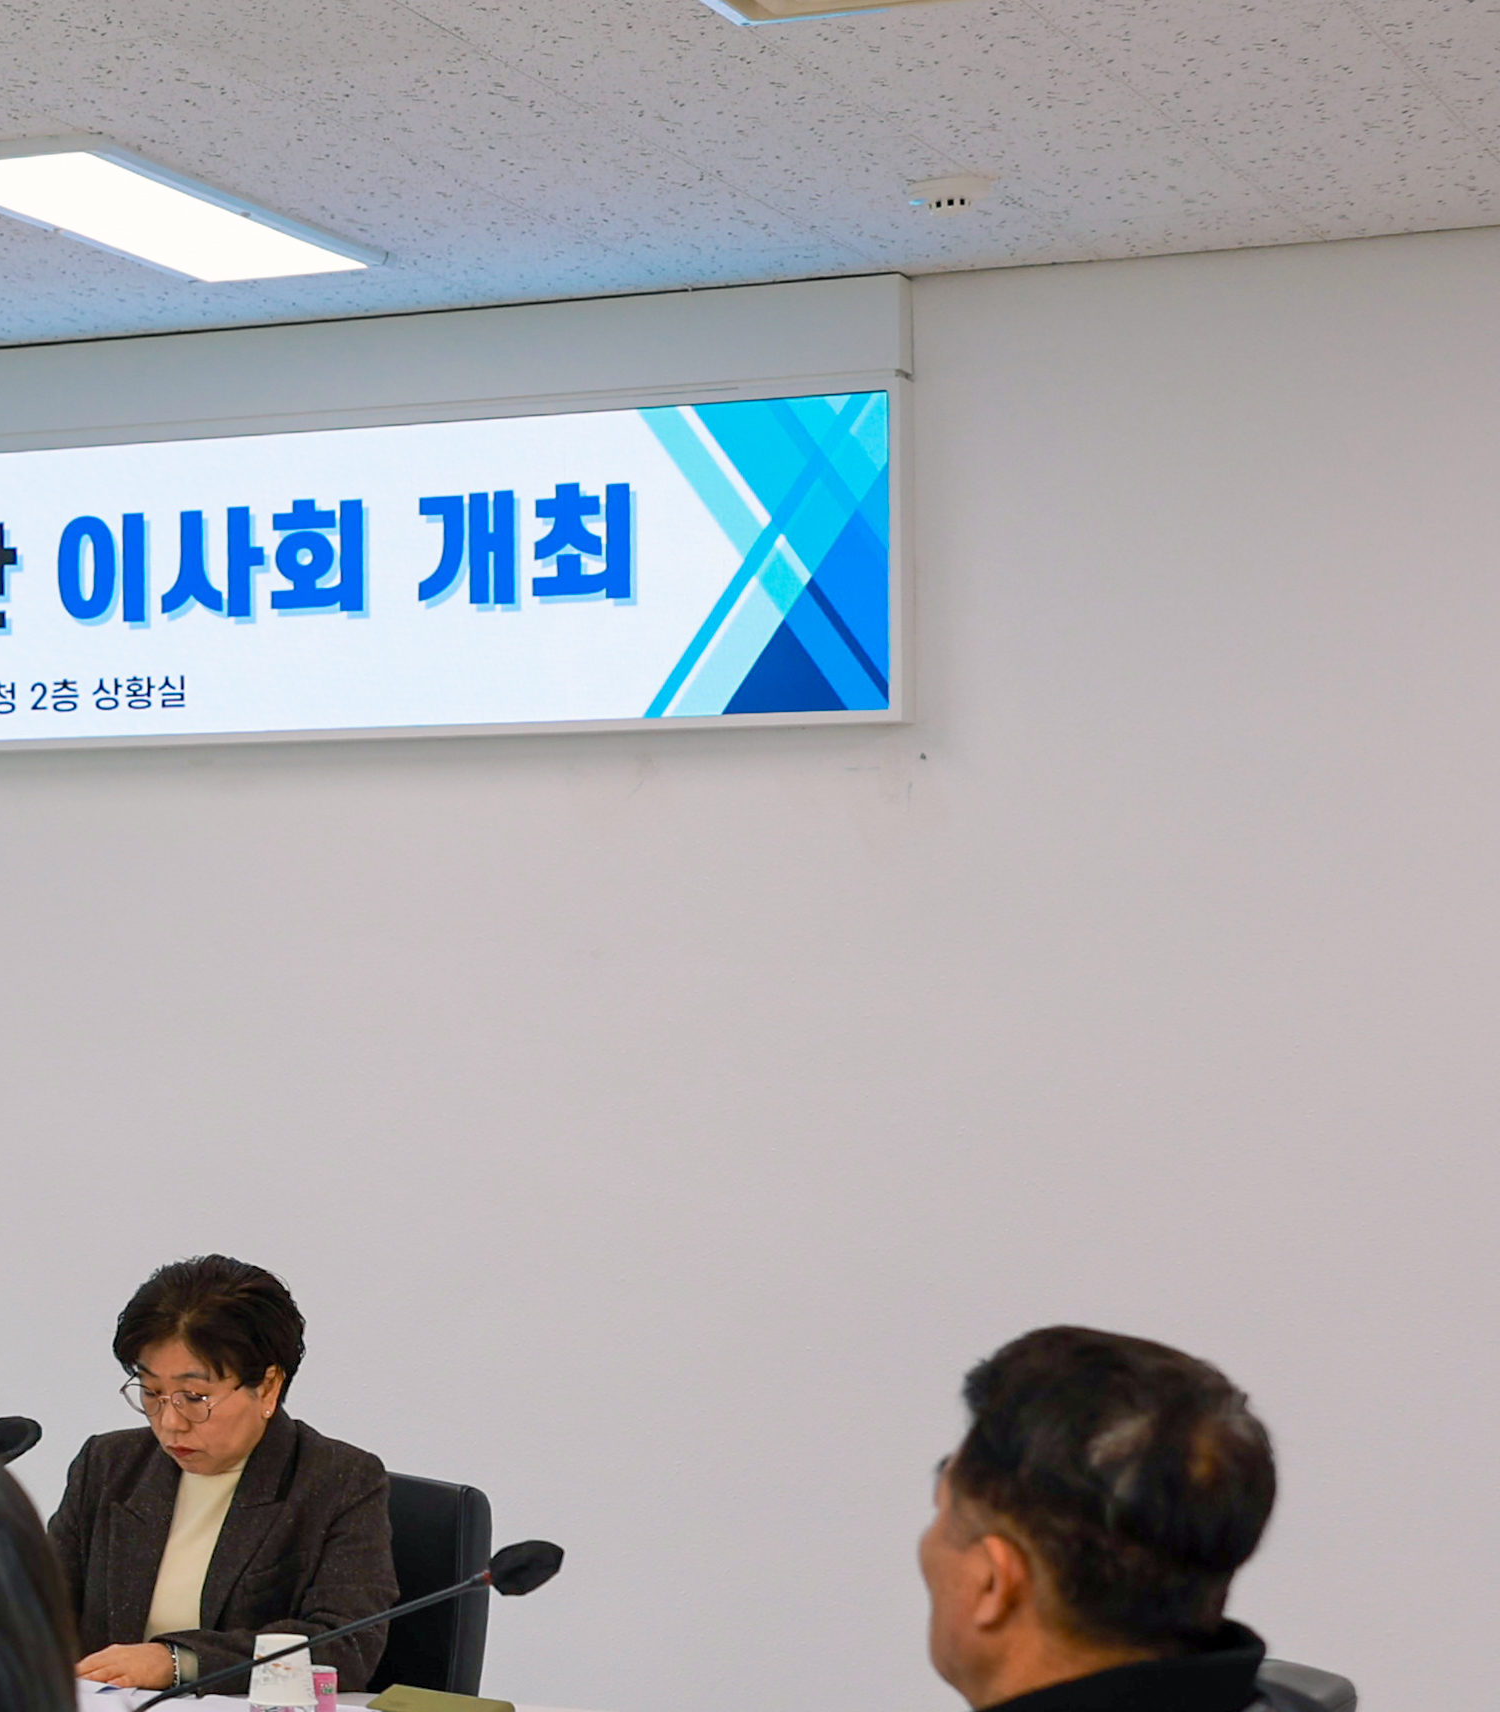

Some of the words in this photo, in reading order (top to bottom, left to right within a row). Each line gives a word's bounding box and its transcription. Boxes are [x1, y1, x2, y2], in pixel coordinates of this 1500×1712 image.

[57, 498, 366, 624] 이사회
[418, 482, 632, 604] 개최
[30, 679, 80, 712] 2층
[91, 674, 188, 710] 상황실
